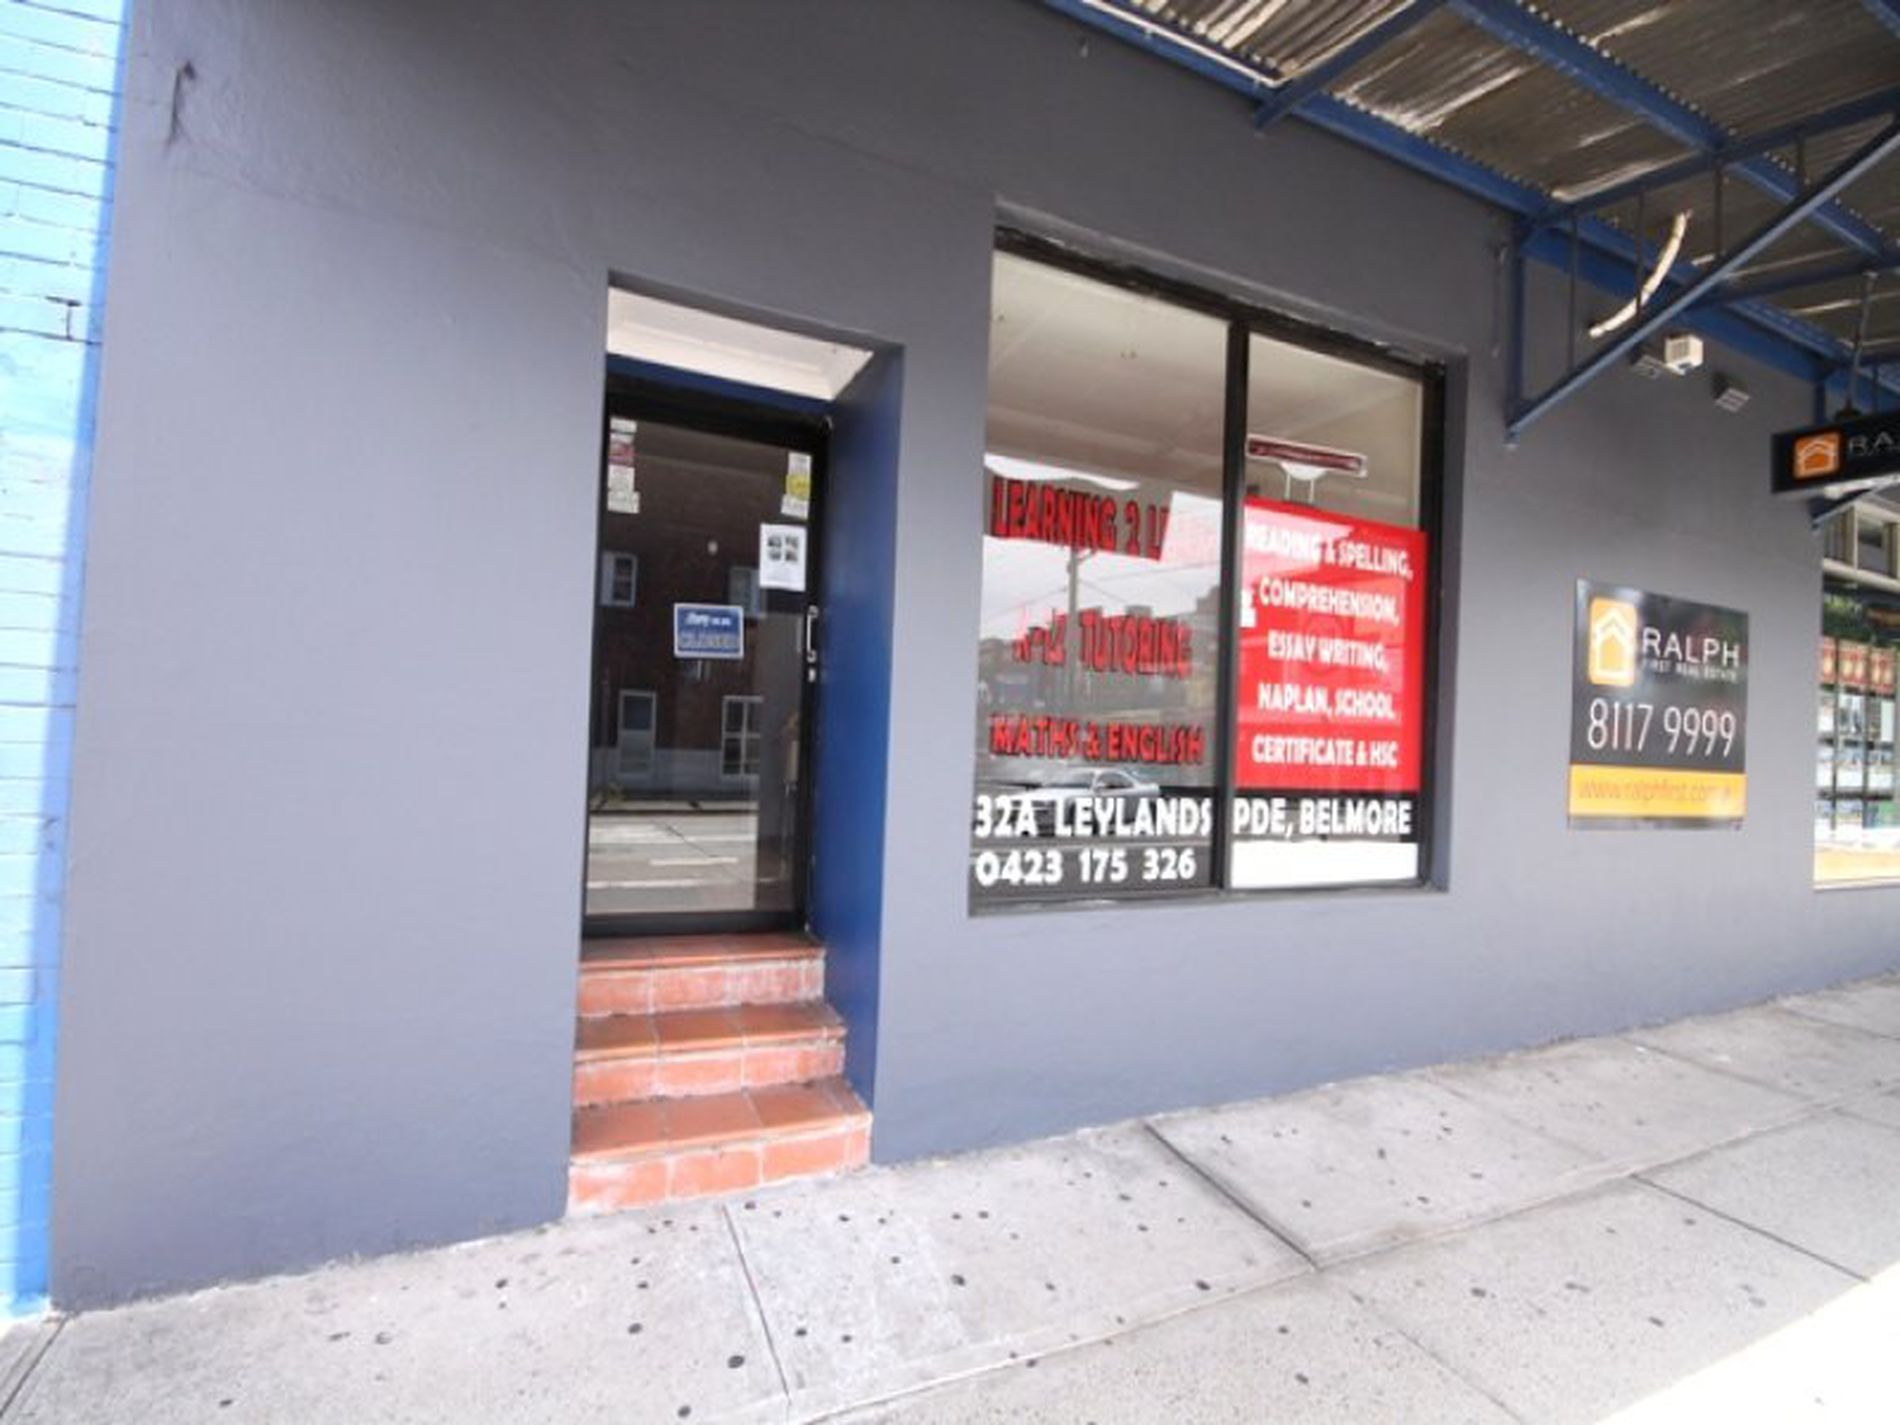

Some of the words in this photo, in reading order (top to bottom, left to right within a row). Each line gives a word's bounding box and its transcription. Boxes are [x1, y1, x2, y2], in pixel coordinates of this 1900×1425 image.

[991, 475, 1116, 553] LEARNING
[1124, 500, 1140, 556] 2
[1079, 608, 1192, 680] TUTORING
[1268, 629, 1316, 665] ESSAY
[1642, 626, 1740, 668] RALPH
[1259, 682, 1332, 720] NAPLAN,
[1335, 689, 1396, 719] SCHOOL
[989, 713, 1079, 758] MATHS
[1086, 721, 1101, 760] &
[1106, 722, 1206, 766] ENGLISH
[1587, 698, 1653, 751] 8117
[1663, 706, 1736, 757] 9999
[1253, 734, 1354, 766] CERTIFICATE
[1356, 740, 1367, 766] &
[1370, 740, 1398, 768] HSC
[974, 795, 1038, 838] 32A
[1054, 797, 1212, 837] LEYLANDS
[1233, 797, 1294, 838] PDE,
[1299, 798, 1412, 835] BELMORE
[975, 850, 1063, 887] 0423
[1079, 848, 1128, 883] 175
[1142, 848, 1197, 881] 326
